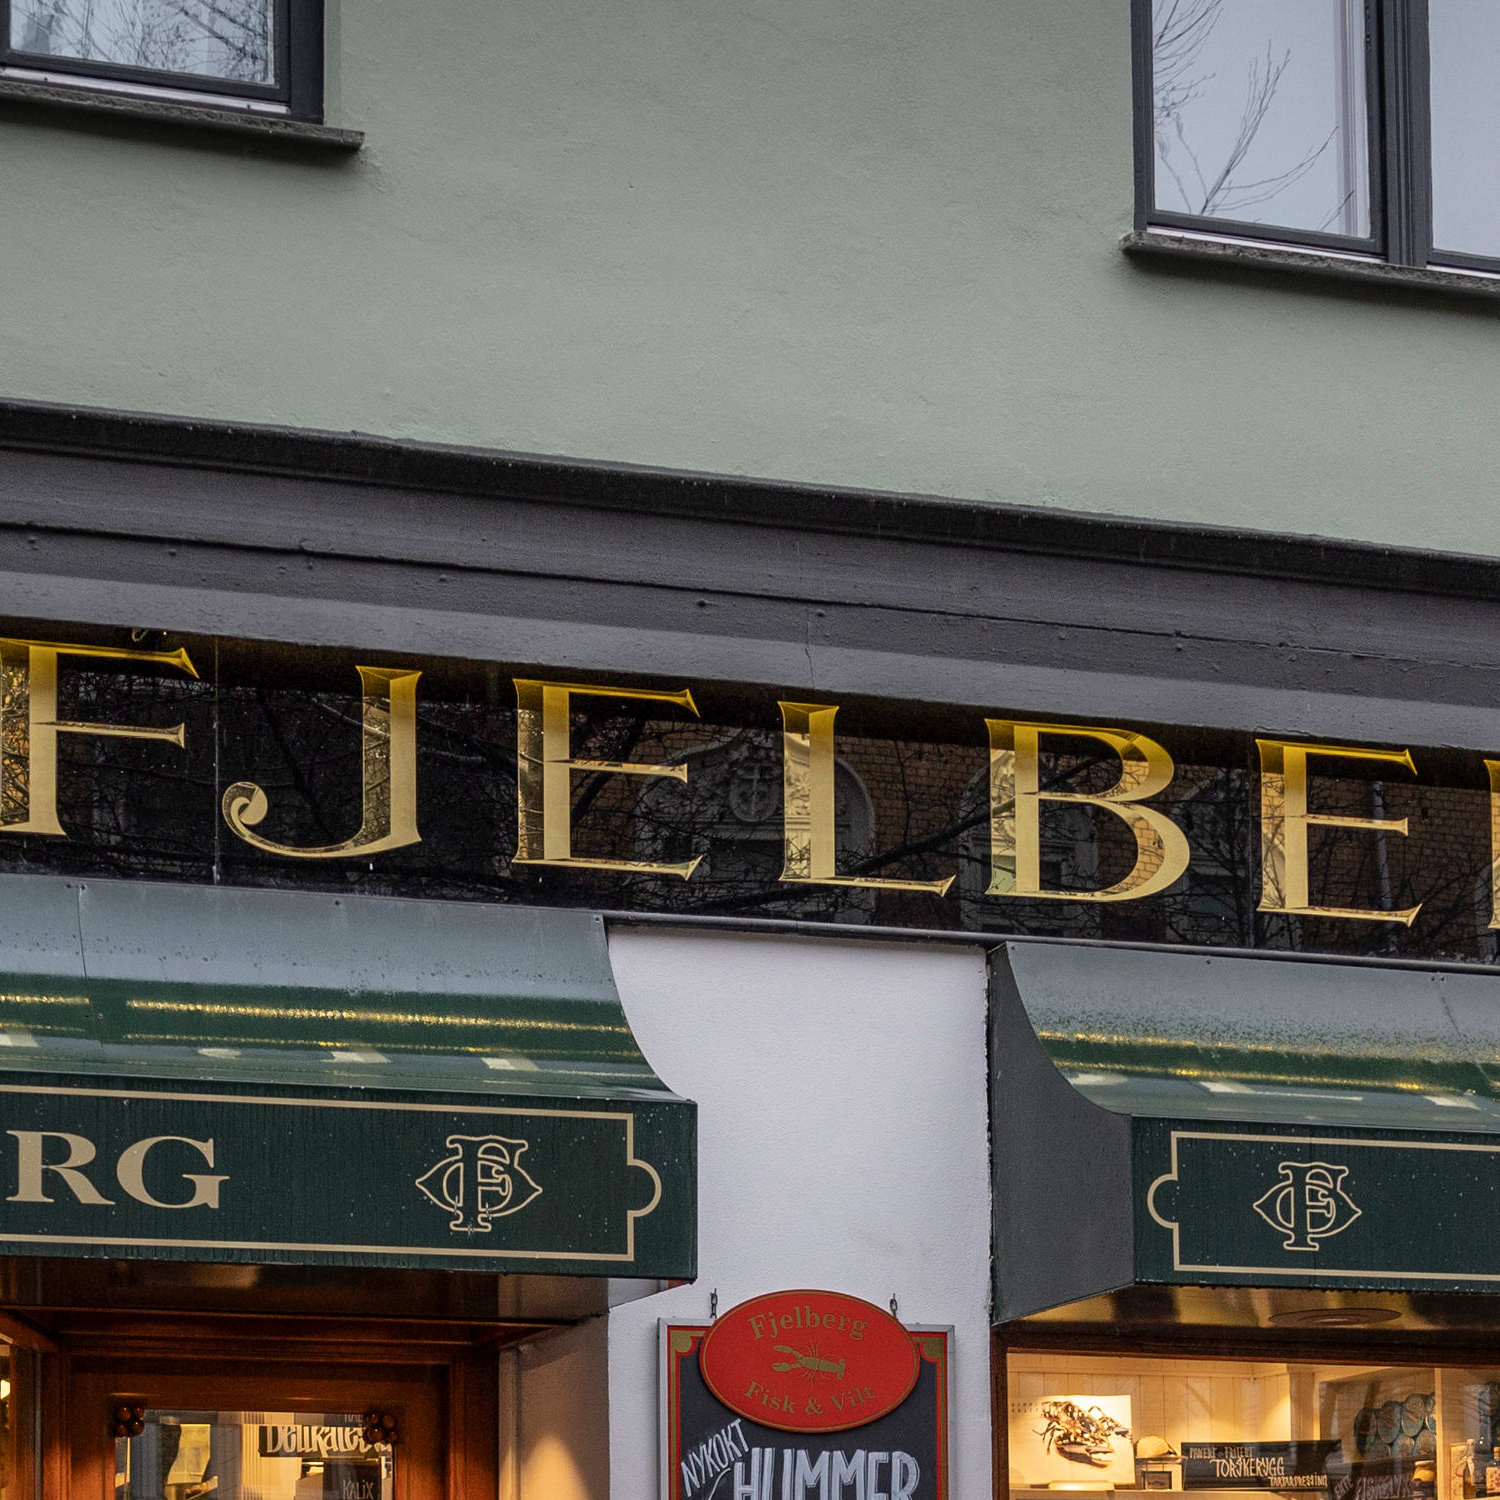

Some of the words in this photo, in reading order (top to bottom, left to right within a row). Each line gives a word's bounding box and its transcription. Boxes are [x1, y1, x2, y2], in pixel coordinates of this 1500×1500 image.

[747, 1304, 870, 1342] Fjelberg
[744, 1380, 797, 1416] Fisk
[804, 1396, 824, 1416] &
[830, 1384, 877, 1412] Vilt
[681, 1418, 749, 1498] NYKOKT
[1209, 1457, 1285, 1478] TORSKERYGG
